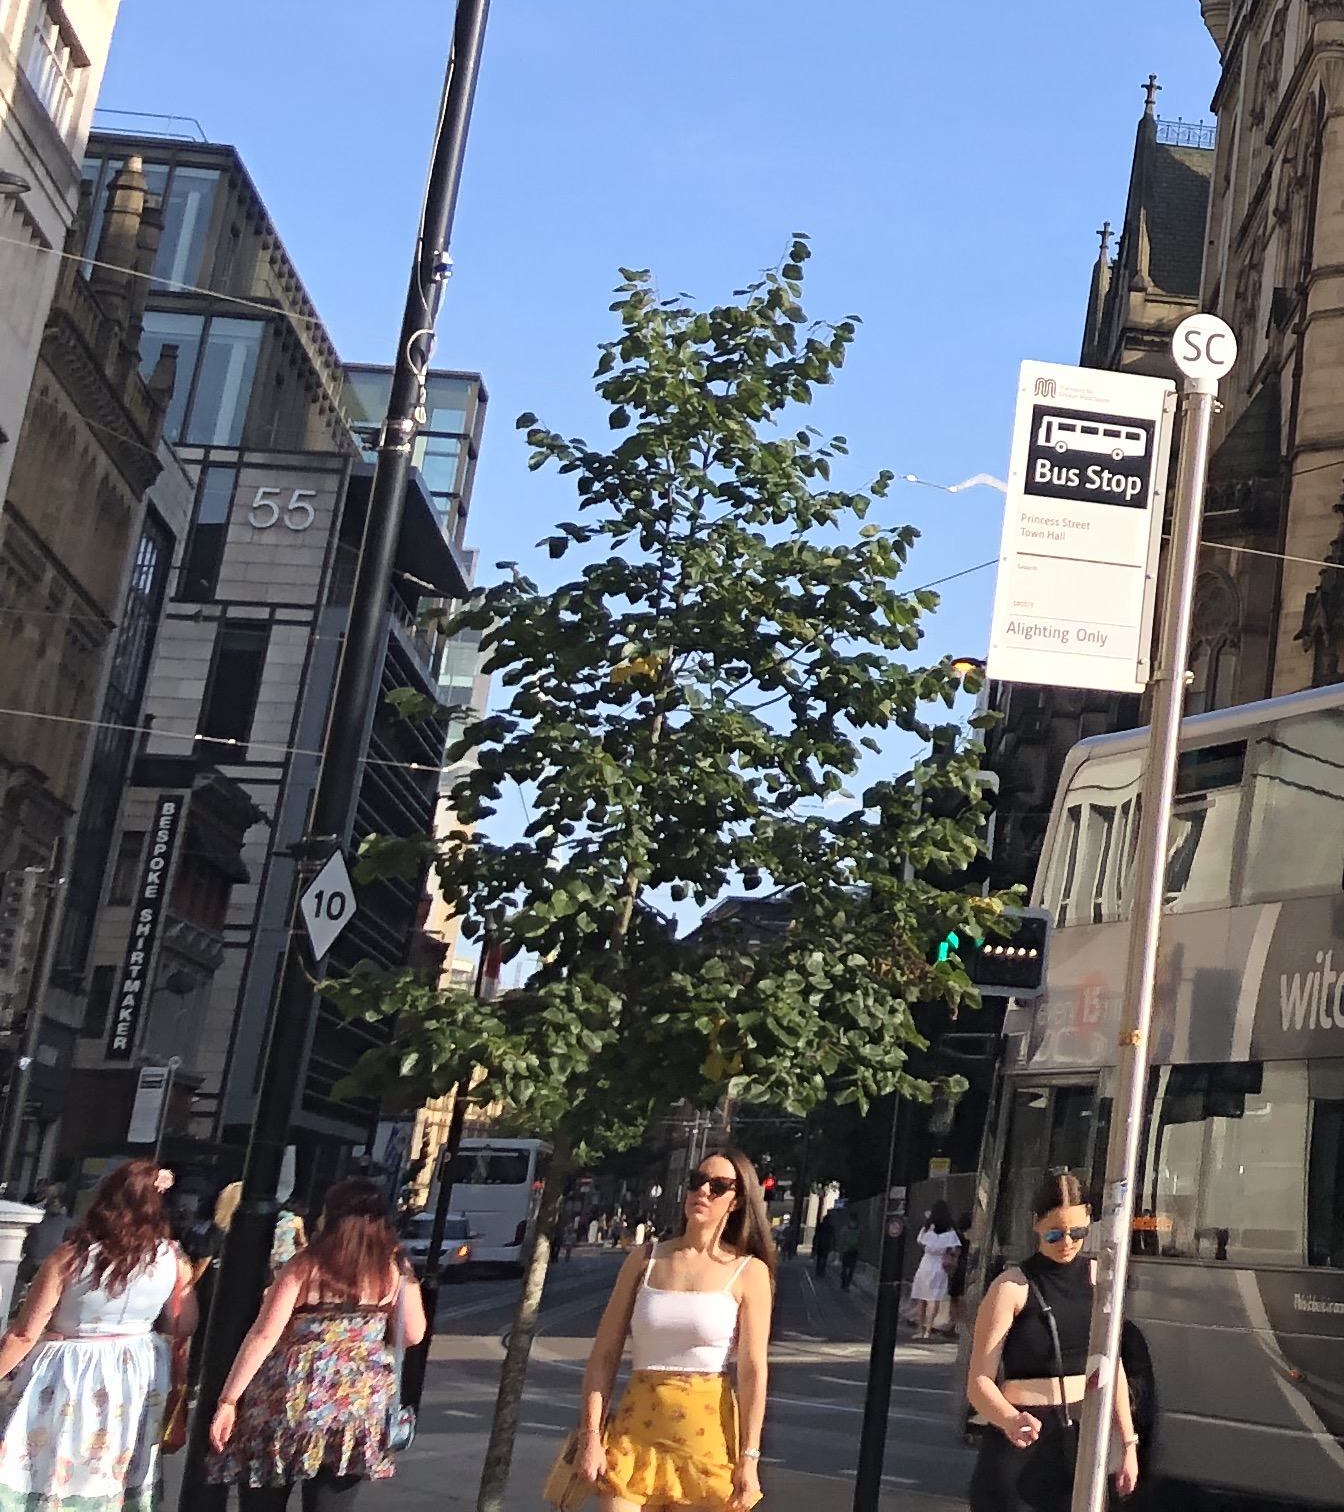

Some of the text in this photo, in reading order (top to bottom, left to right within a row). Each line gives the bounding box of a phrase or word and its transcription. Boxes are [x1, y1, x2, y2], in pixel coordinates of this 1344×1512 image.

[1183, 330, 1225, 365] SC
[1034, 458, 1142, 500] Bus Stop
[248, 488, 316, 530] 55
[1021, 513, 1091, 530] Princess Street
[1021, 527, 1066, 541] Town Hall
[1006, 621, 1109, 648] Alighting Only
[144, 802, 176, 898] BESPOKE
[315, 890, 346, 921] 10
[113, 908, 153, 1050] SHIRTMAKER
